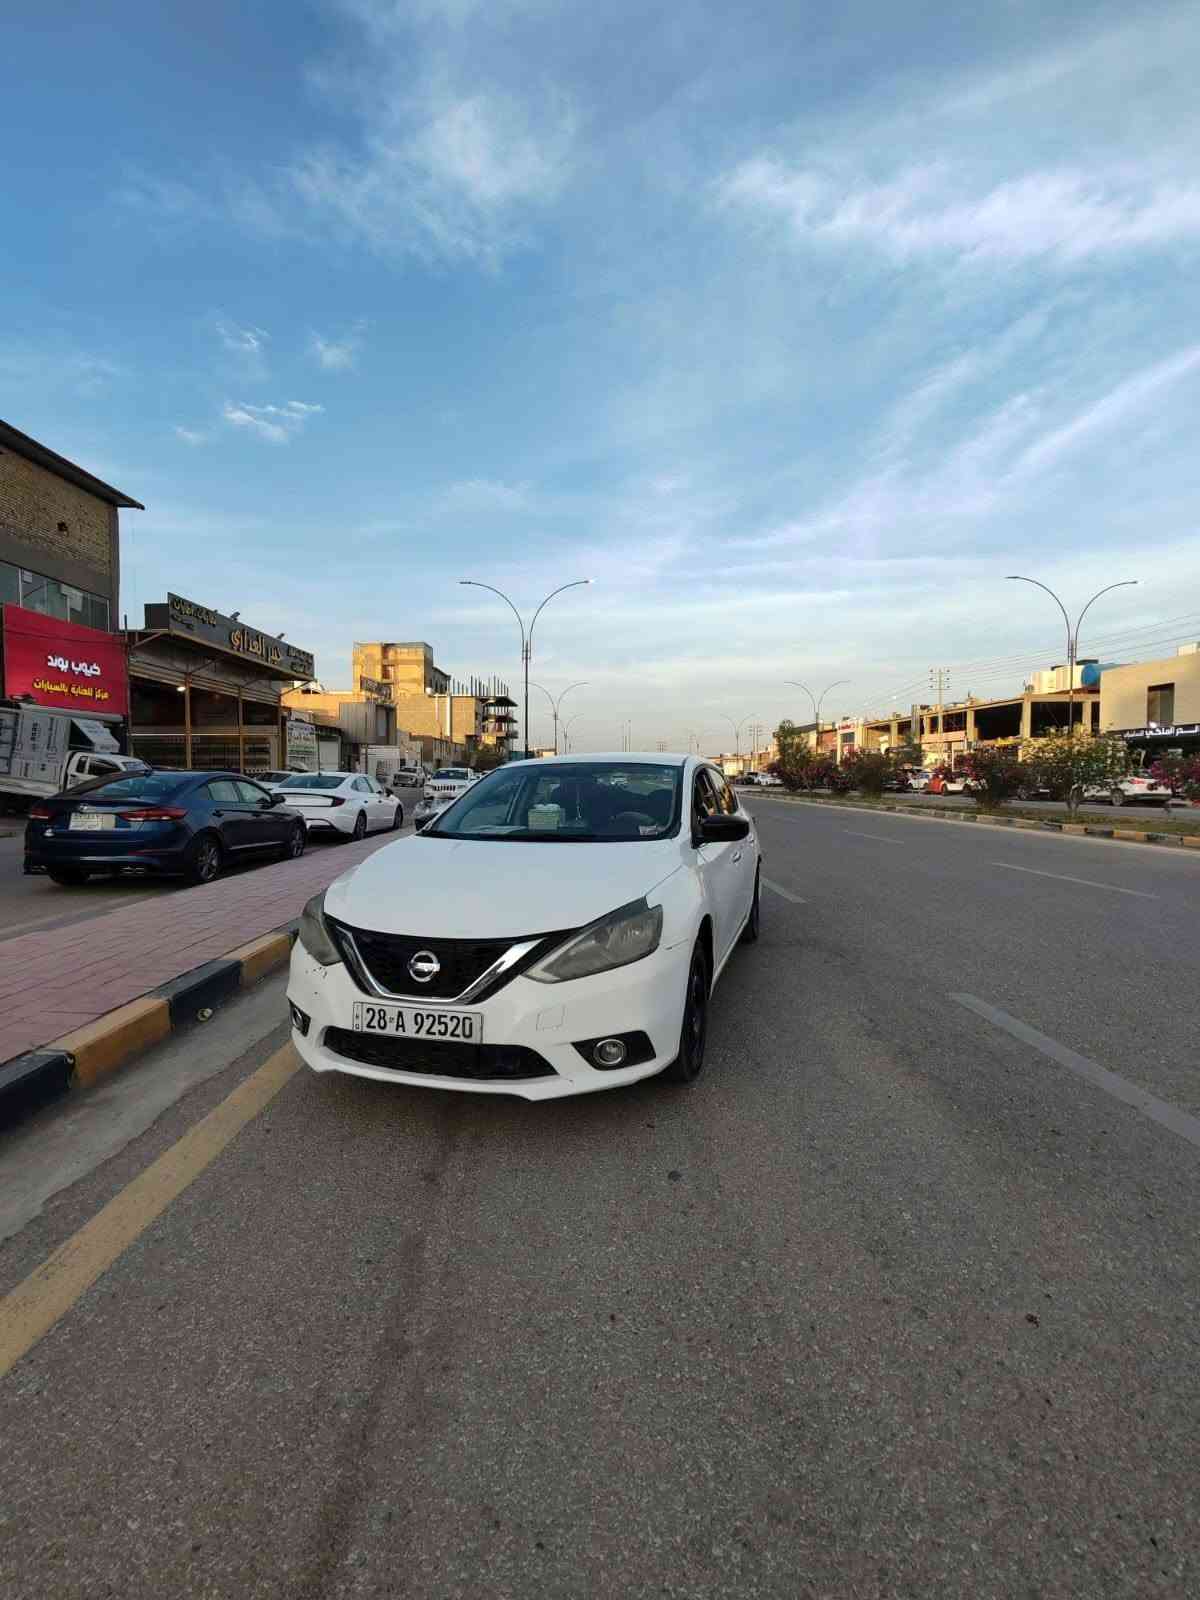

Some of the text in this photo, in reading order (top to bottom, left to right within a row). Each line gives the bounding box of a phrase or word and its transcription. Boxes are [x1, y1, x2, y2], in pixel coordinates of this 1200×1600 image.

[72, 661, 101, 677] كيوب
[95, 687, 109, 700] مركز
[366, 1007, 473, 1038] 28 A 92520
